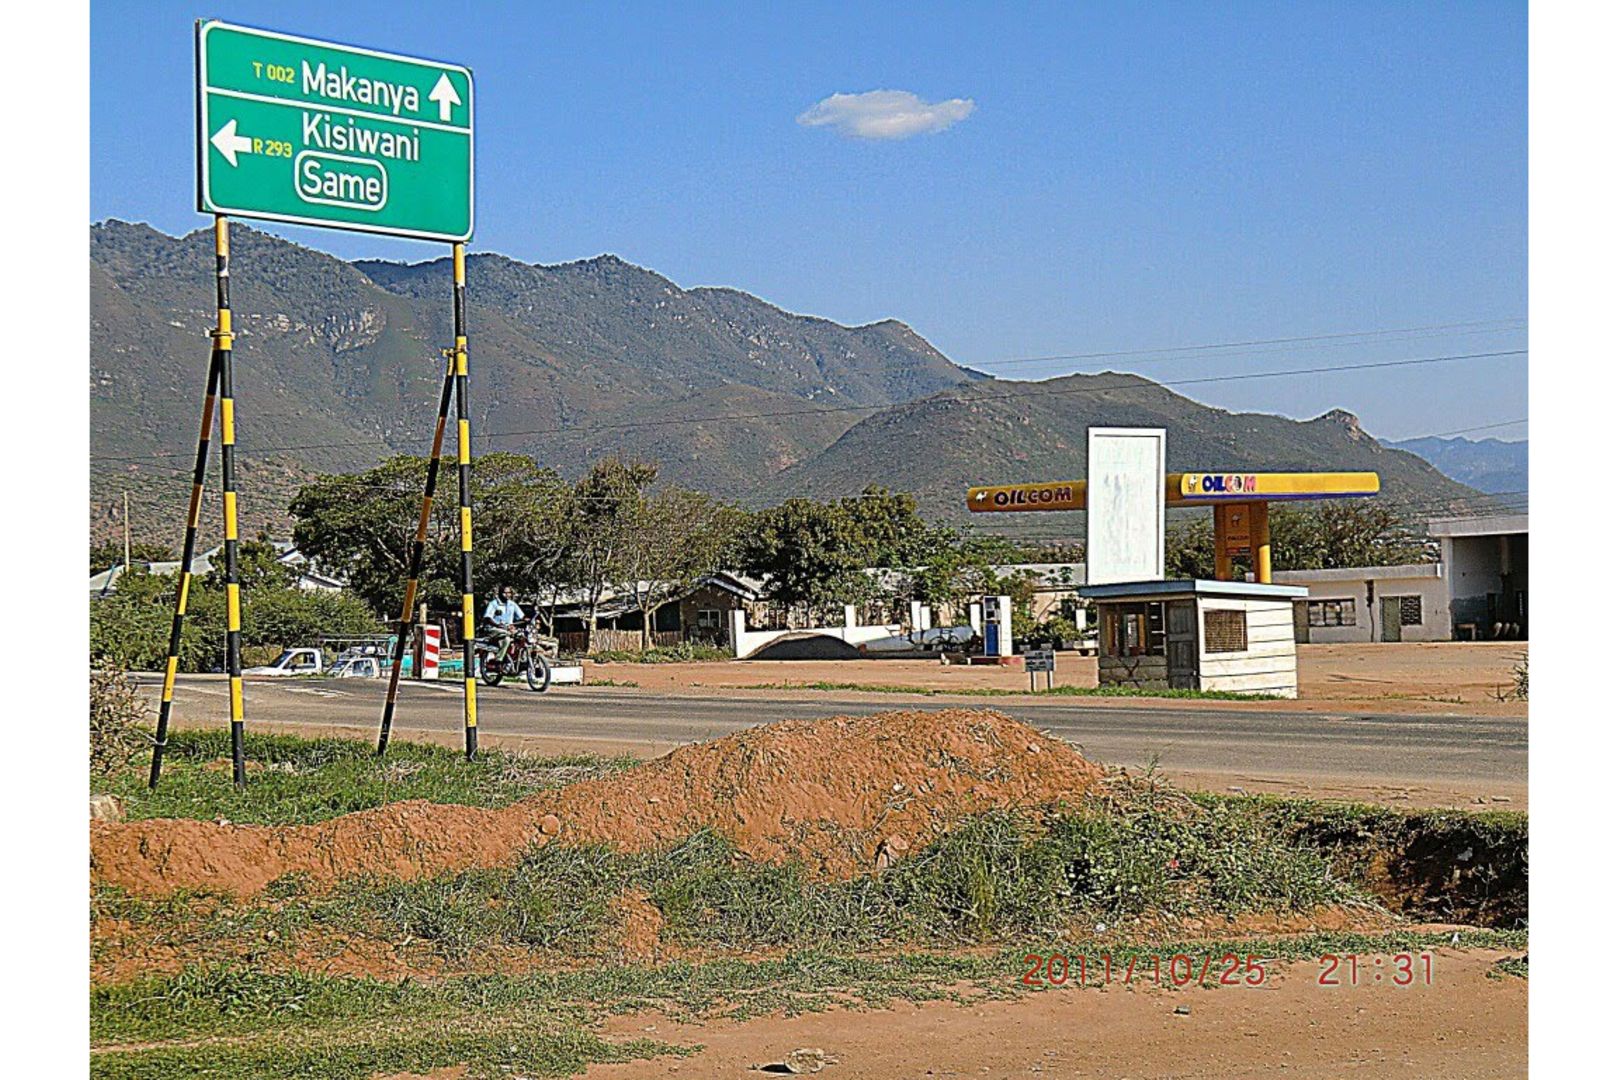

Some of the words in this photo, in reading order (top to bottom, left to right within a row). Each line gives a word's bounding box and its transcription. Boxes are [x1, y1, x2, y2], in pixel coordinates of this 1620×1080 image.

[252, 61, 263, 79] T
[266, 64, 295, 84] 002
[302, 60, 419, 116] Makanya
[253, 138, 263, 154] R
[265, 140, 293, 158] 293
[302, 111, 420, 161] Kisiwani
[302, 160, 381, 202] Same
[994, 486, 1073, 507] OILCOM
[1202, 475, 1257, 492] OILCOM
